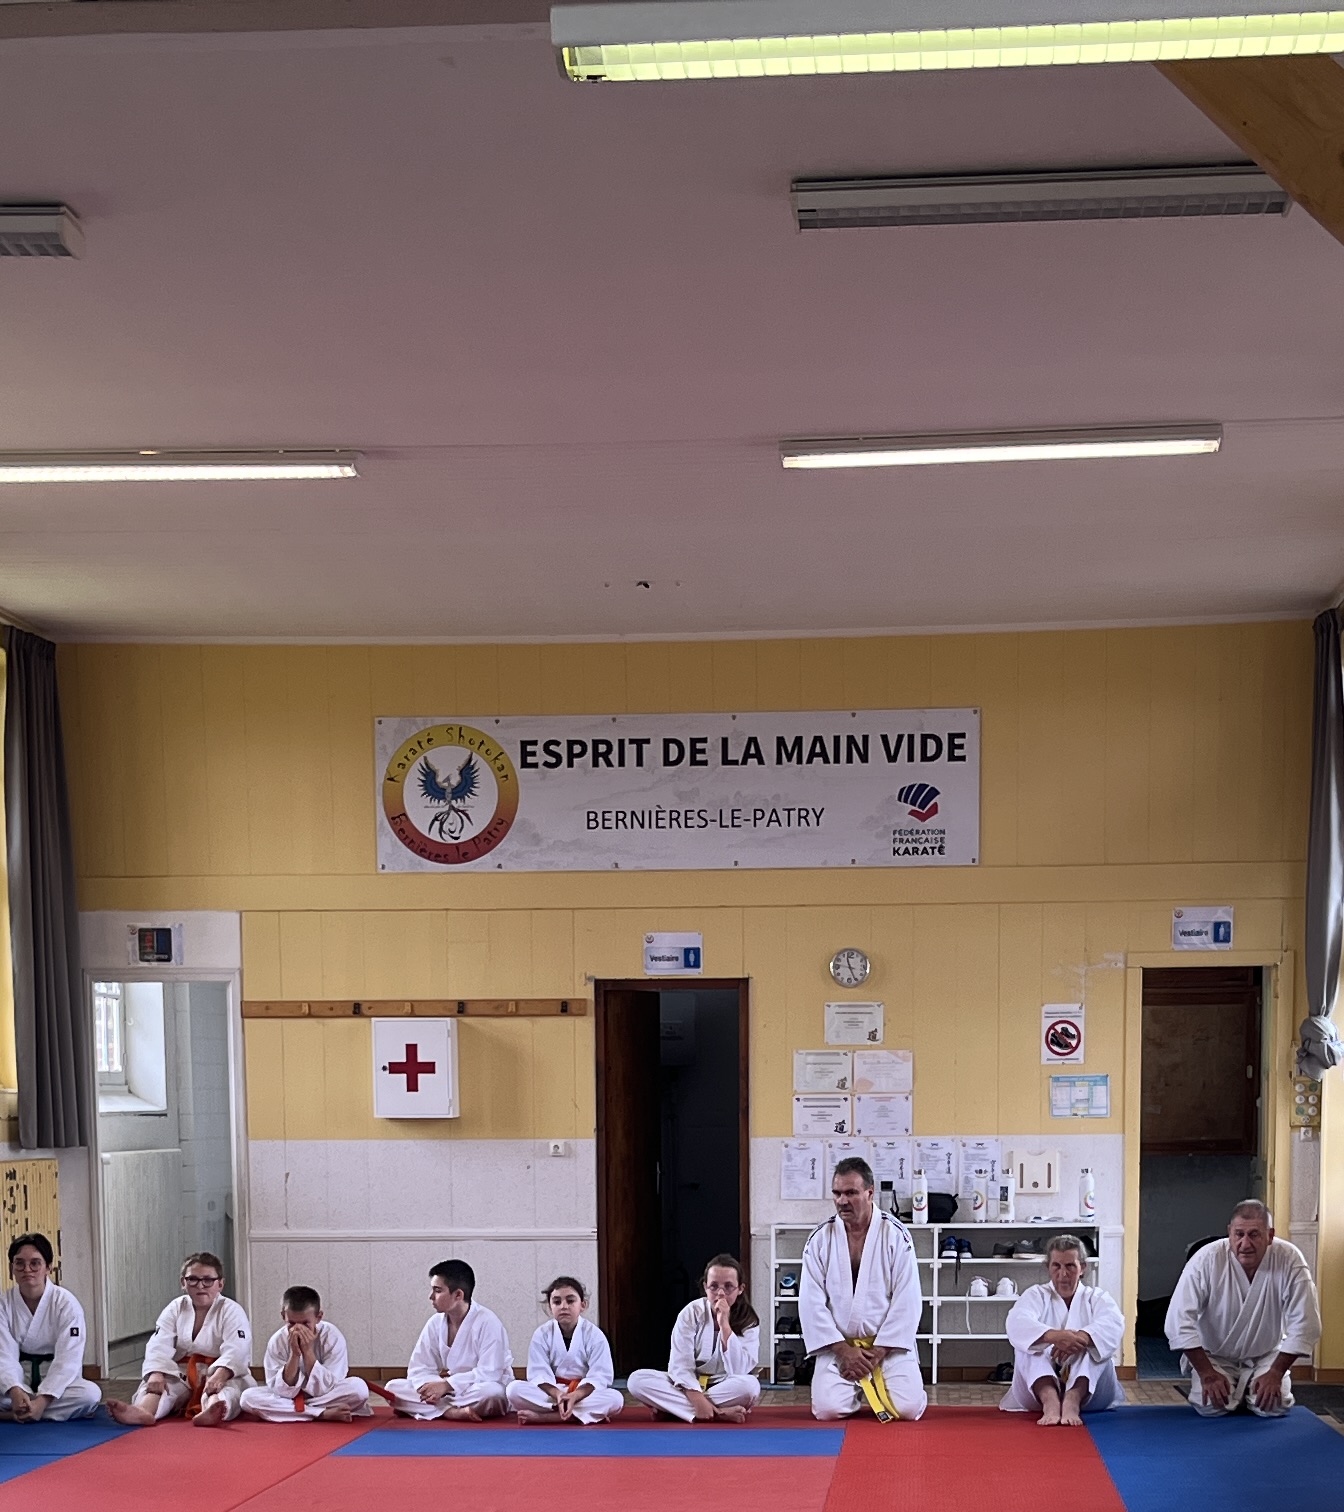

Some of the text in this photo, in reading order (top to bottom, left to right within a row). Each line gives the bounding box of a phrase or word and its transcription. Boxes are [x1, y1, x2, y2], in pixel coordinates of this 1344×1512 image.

[386, 726, 510, 784] Karaté Shotokan
[519, 732, 967, 769] ESPRIT DE LA MAIN VIDE
[586, 805, 825, 831] BERNIÈRES-LE-PATRY
[391, 812, 510, 863] Bernières le Patry
[892, 828, 946, 836] FÉDÉRATION
[892, 844, 946, 856] KARATÉ
[1179, 929, 1208, 937] Vestiaire
[649, 954, 679, 962] Vestiaire
